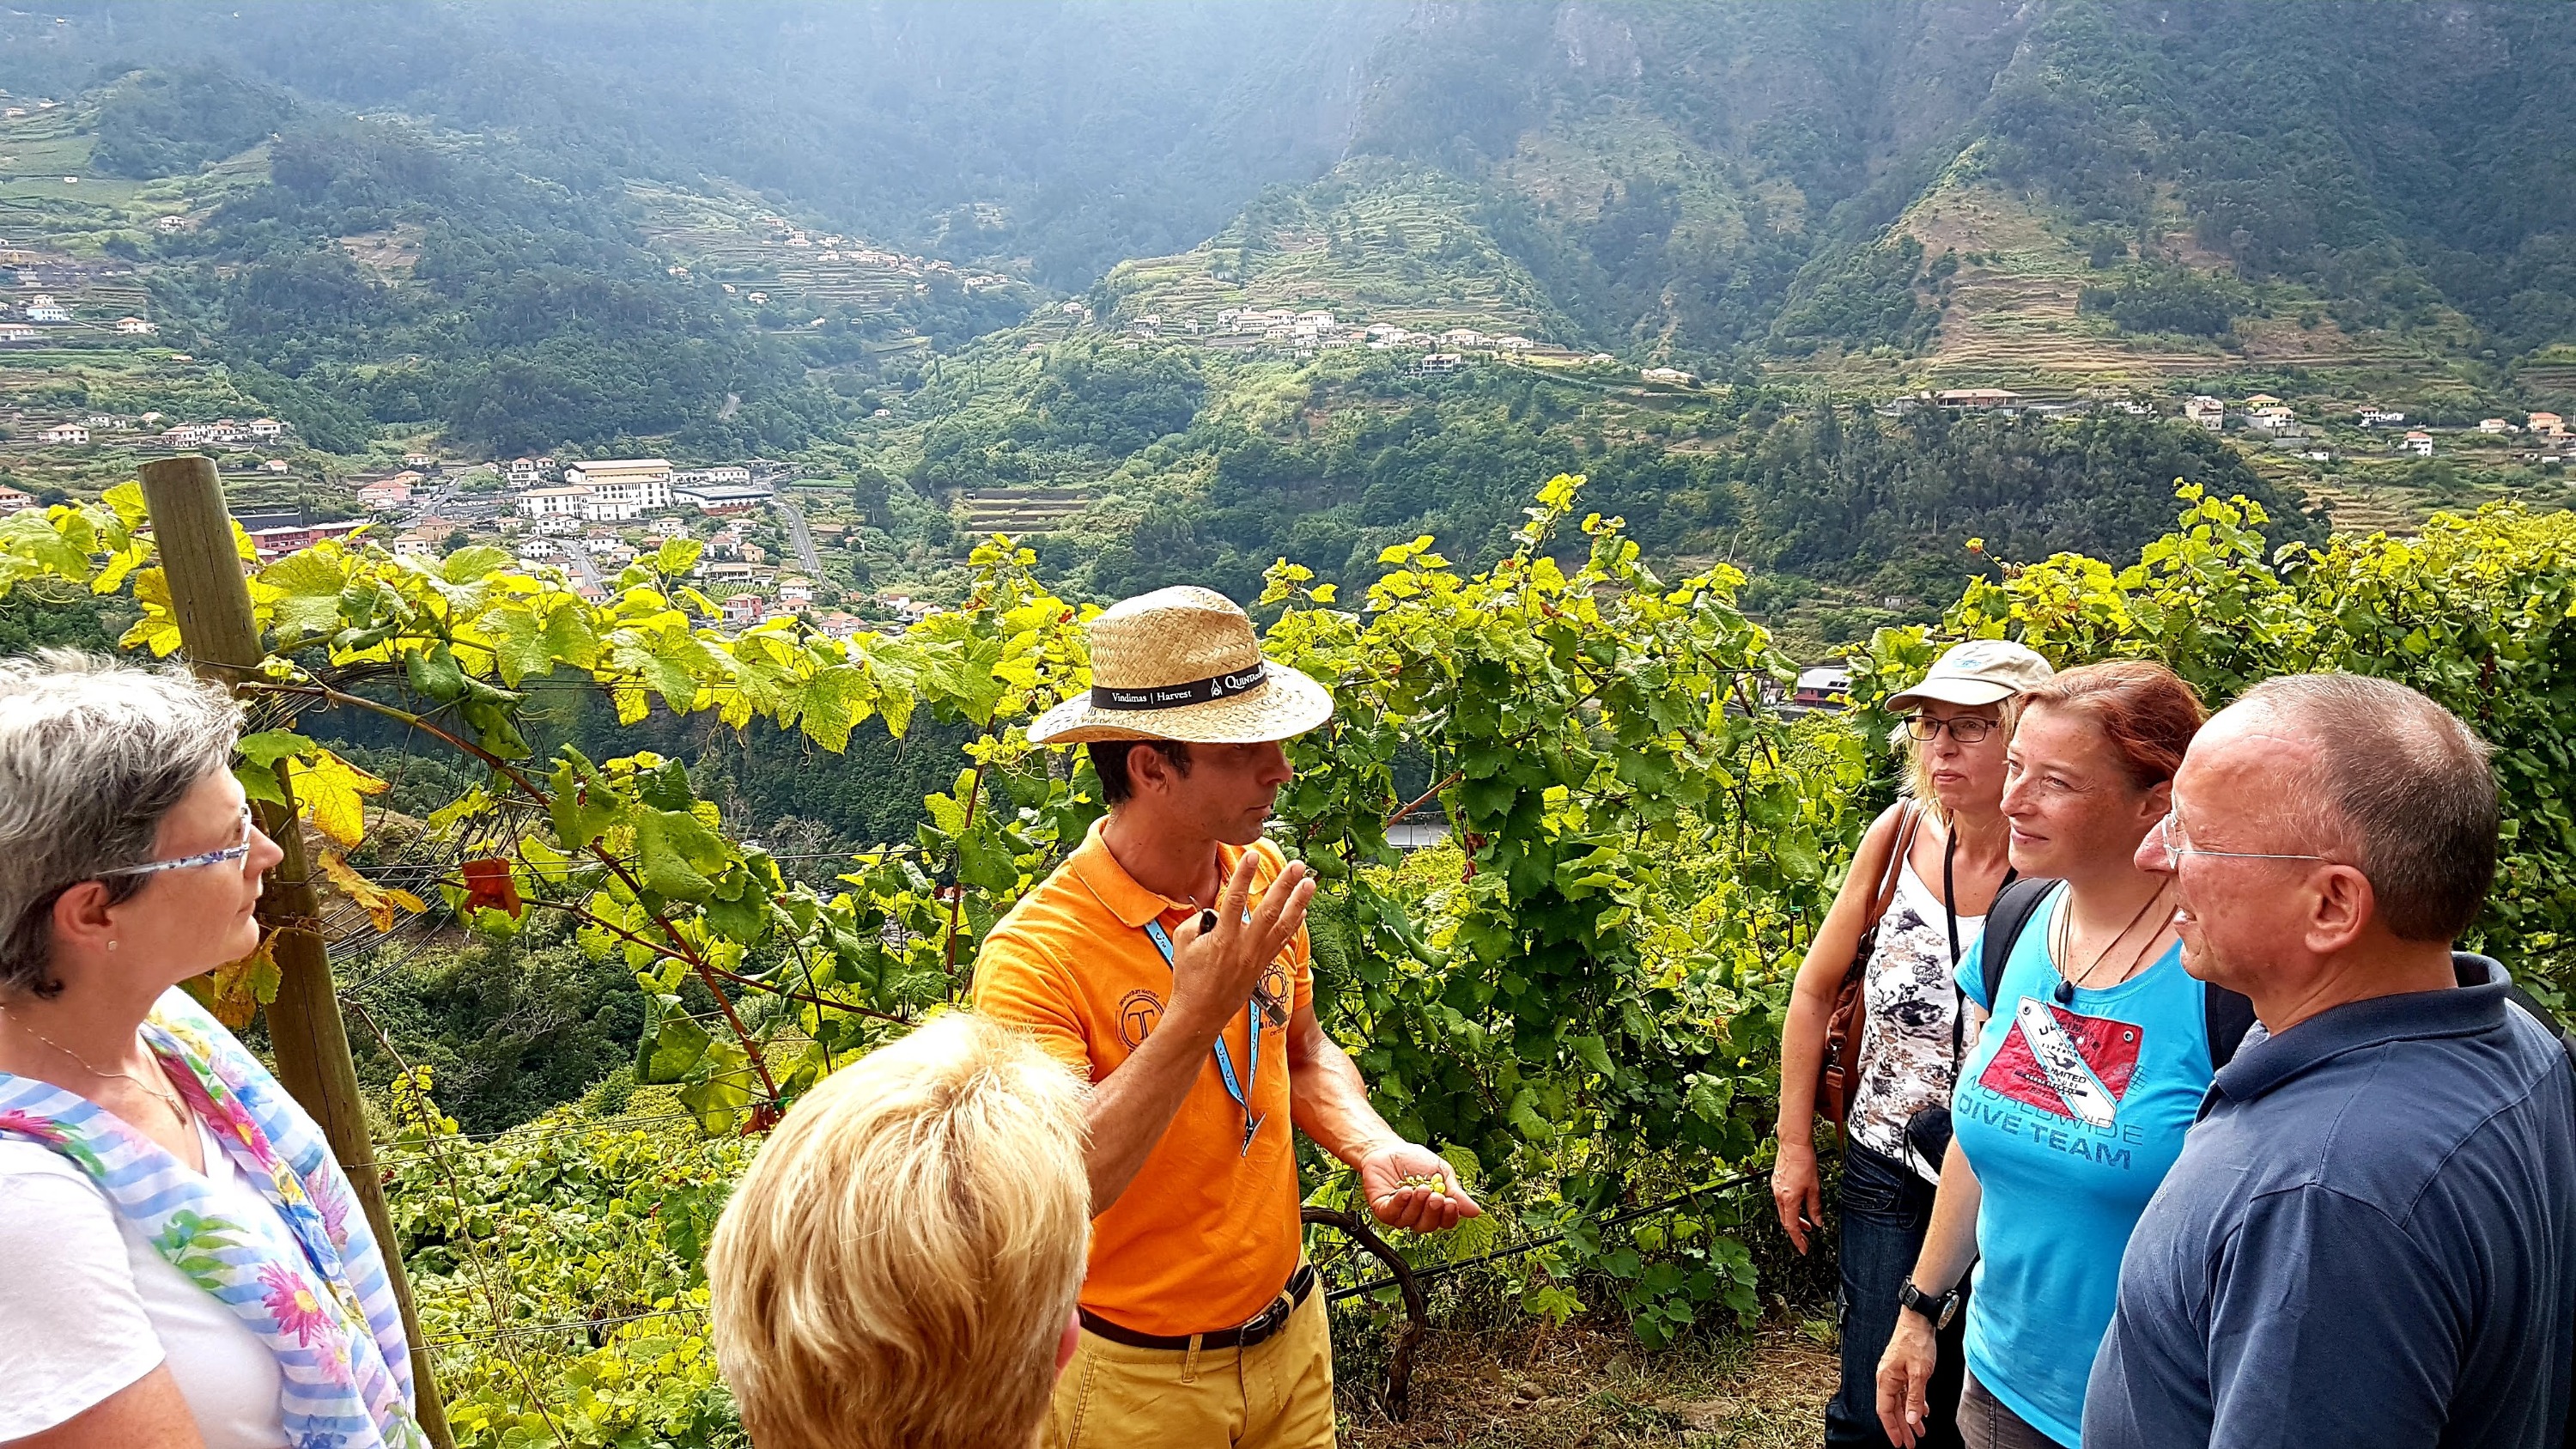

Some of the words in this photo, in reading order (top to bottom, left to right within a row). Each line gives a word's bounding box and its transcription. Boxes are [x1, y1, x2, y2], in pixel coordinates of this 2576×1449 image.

[1111, 692, 1147, 703] Vindimas
[1157, 690, 1193, 702] Harvest
[1957, 1093, 2022, 1135] DIVE
[2030, 1122, 2132, 1171] TEAM
